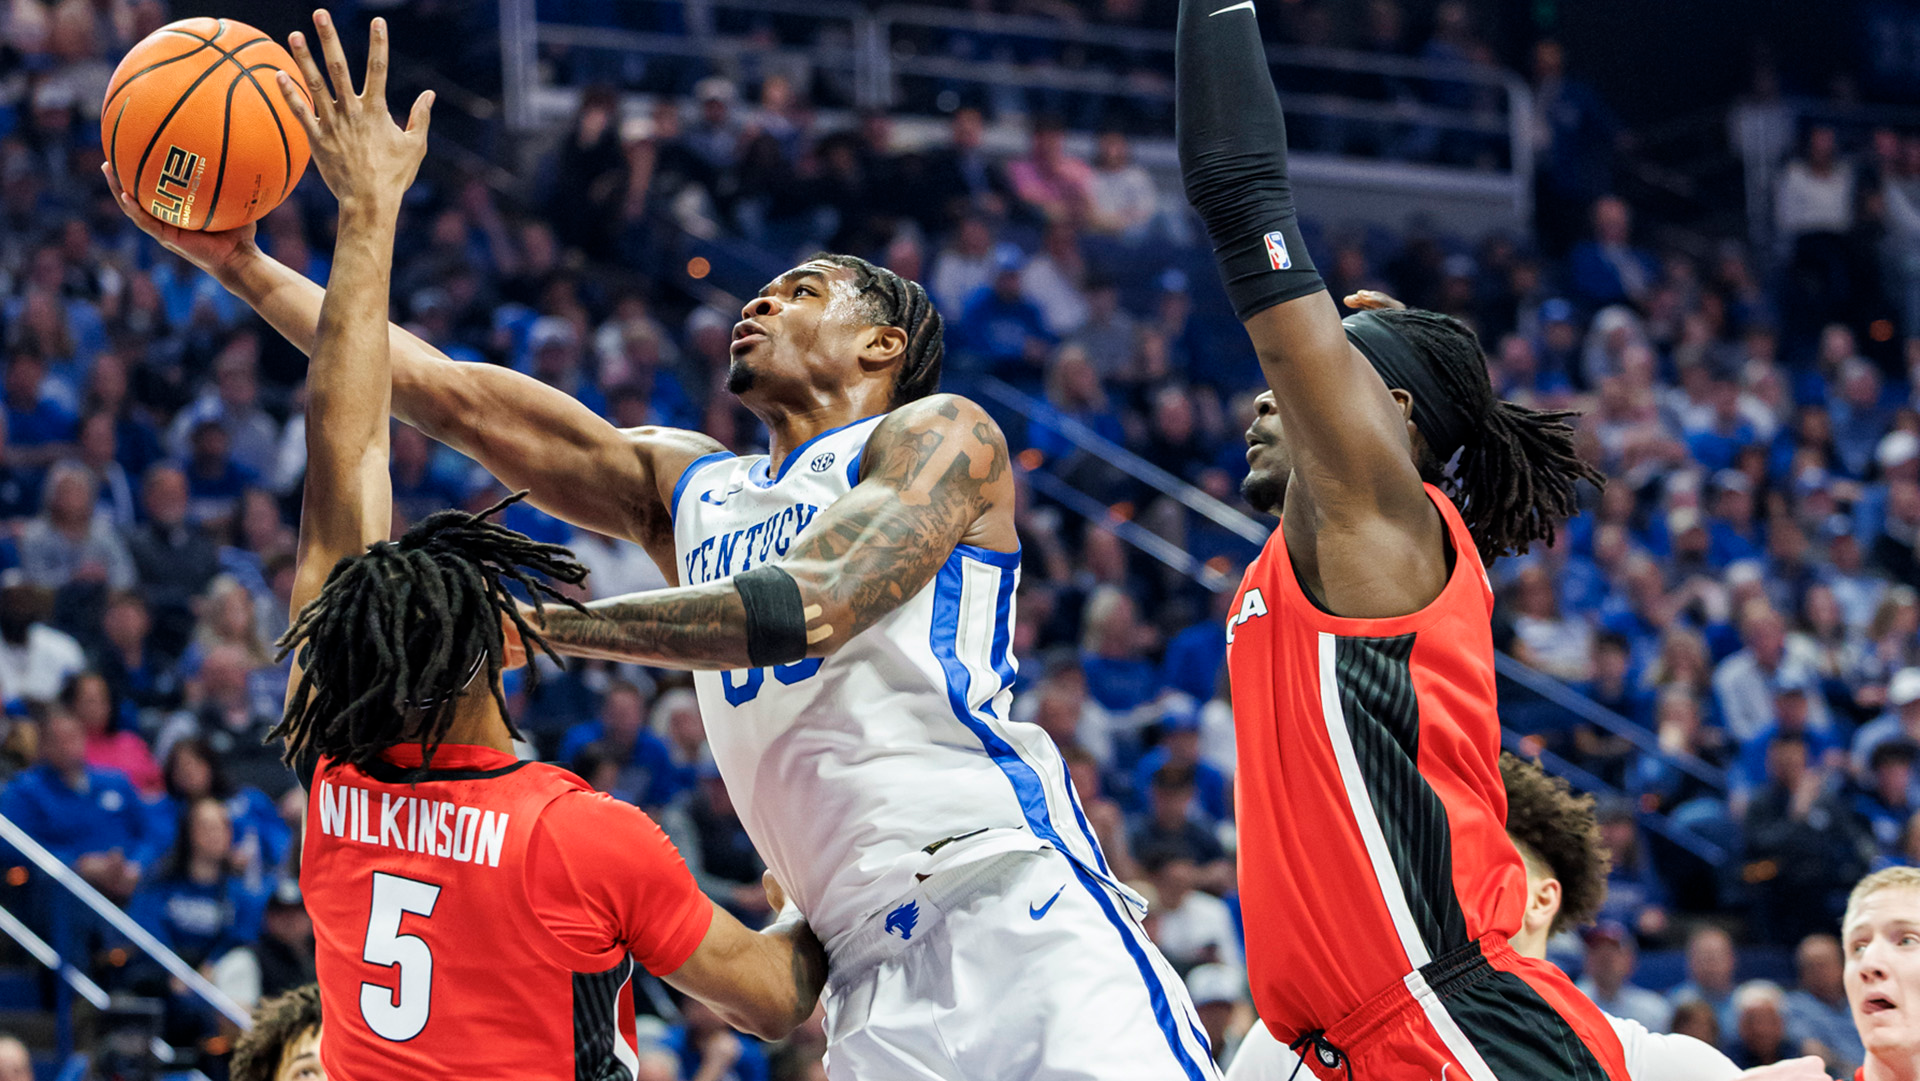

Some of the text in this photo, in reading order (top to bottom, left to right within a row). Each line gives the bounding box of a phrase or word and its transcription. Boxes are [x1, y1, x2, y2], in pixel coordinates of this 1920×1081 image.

[152, 144, 199, 225] ELITE
[811, 452, 835, 472] SEC
[685, 503, 818, 586] KENTUCK
[319, 779, 510, 868] WILKINSON
[360, 870, 442, 1043] 5
